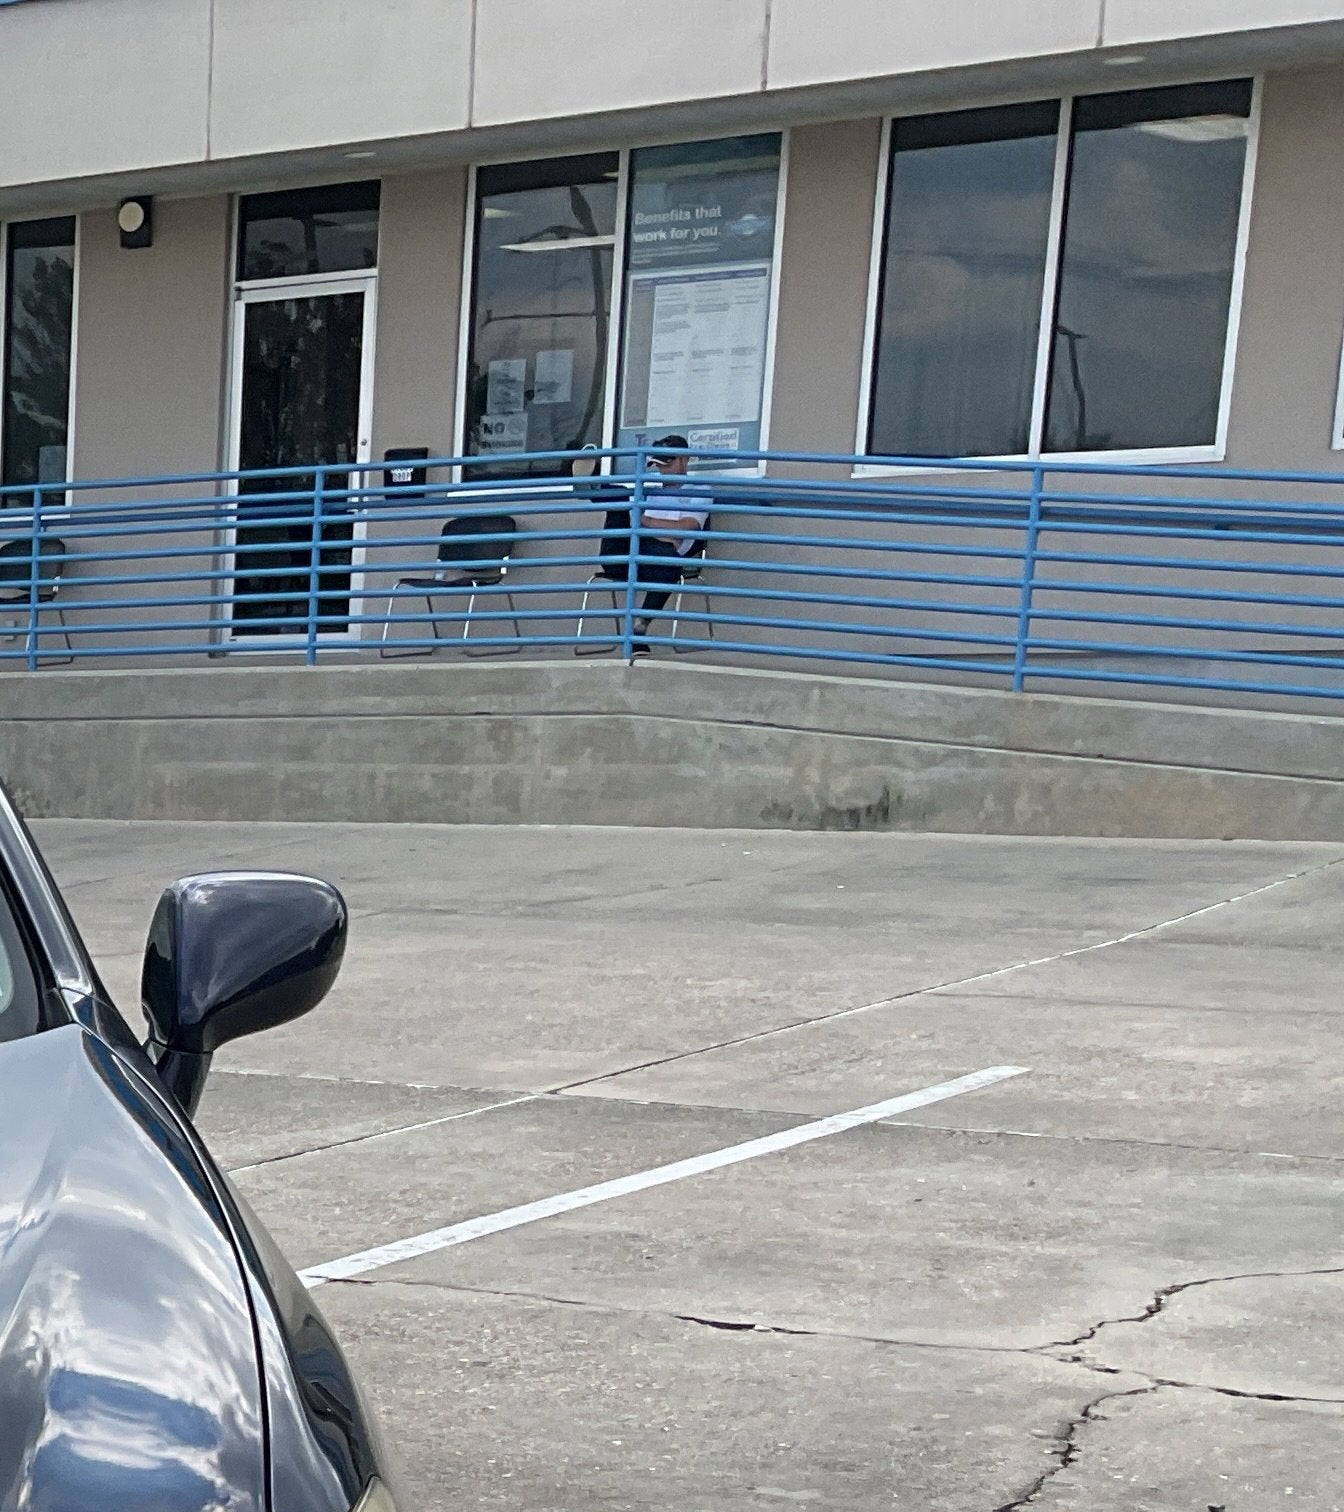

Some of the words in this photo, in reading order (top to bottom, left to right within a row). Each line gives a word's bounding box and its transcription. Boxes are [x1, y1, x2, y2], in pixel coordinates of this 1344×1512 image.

[635, 208, 690, 225] Benefits
[696, 205, 722, 219] that
[633, 230, 667, 243] work
[670, 227, 690, 240] for
[693, 226, 721, 241] you.
[483, 421, 505, 435] NO
